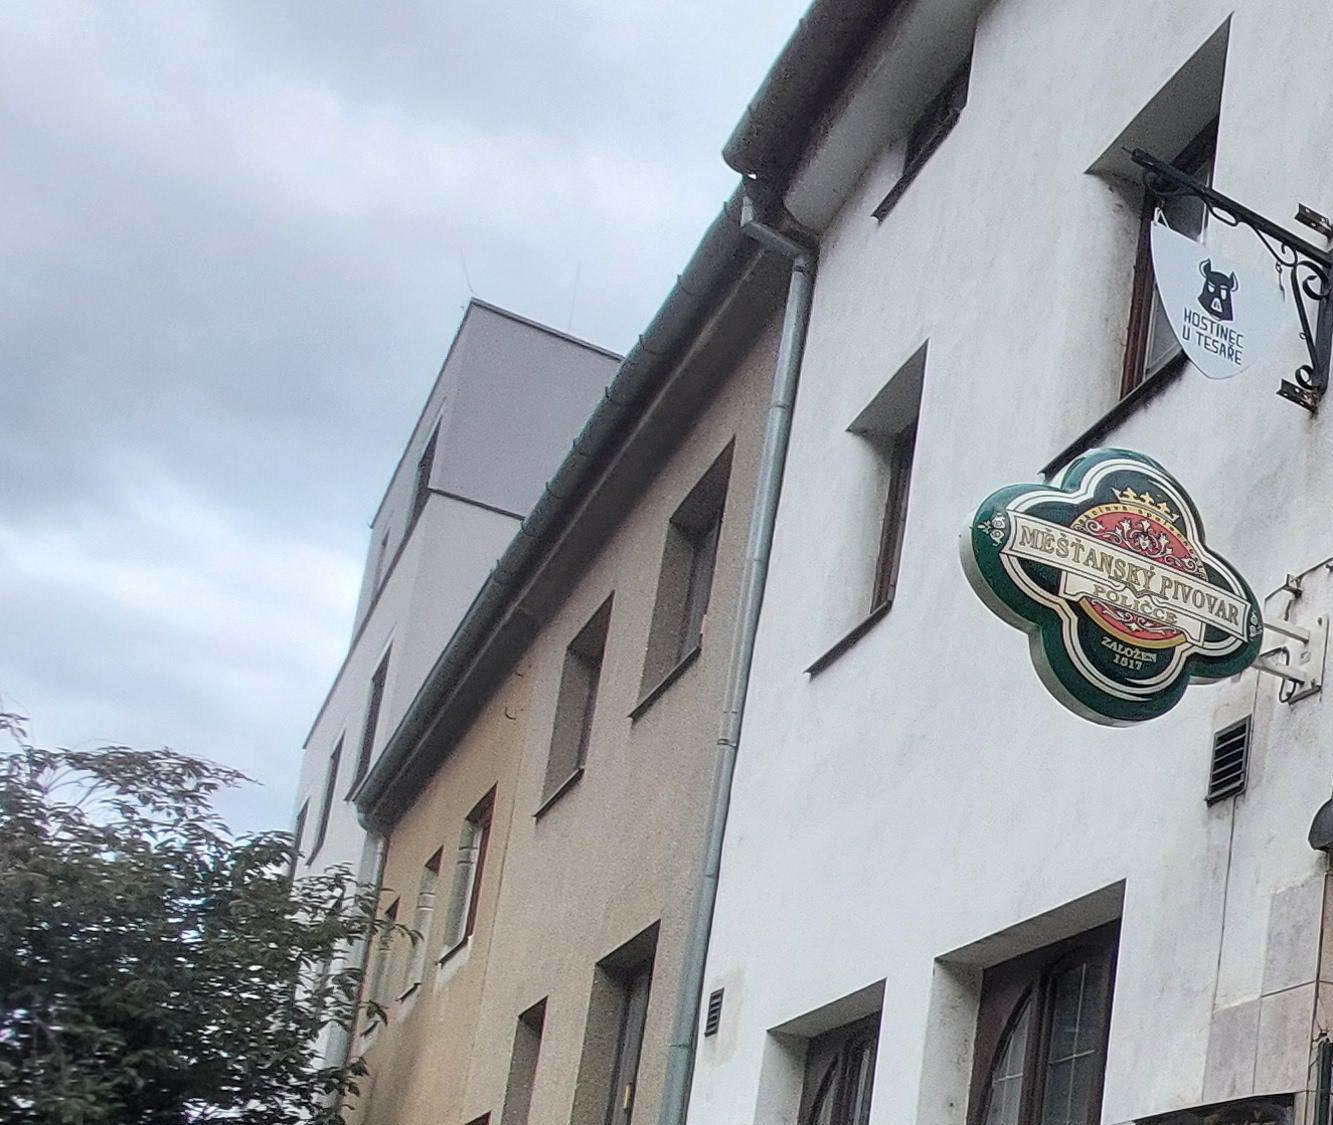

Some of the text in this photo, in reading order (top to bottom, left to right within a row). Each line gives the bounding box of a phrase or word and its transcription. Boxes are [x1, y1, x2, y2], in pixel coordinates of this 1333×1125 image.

[1182, 325, 1242, 366] U TESAŘE
[1183, 306, 1244, 349] HOSTINEC
[1019, 525, 1156, 591] MĚŠŤANSKÝ
[1159, 575, 1239, 626] PIVOVAR
[1101, 636, 1158, 662] ZALOŽEN
